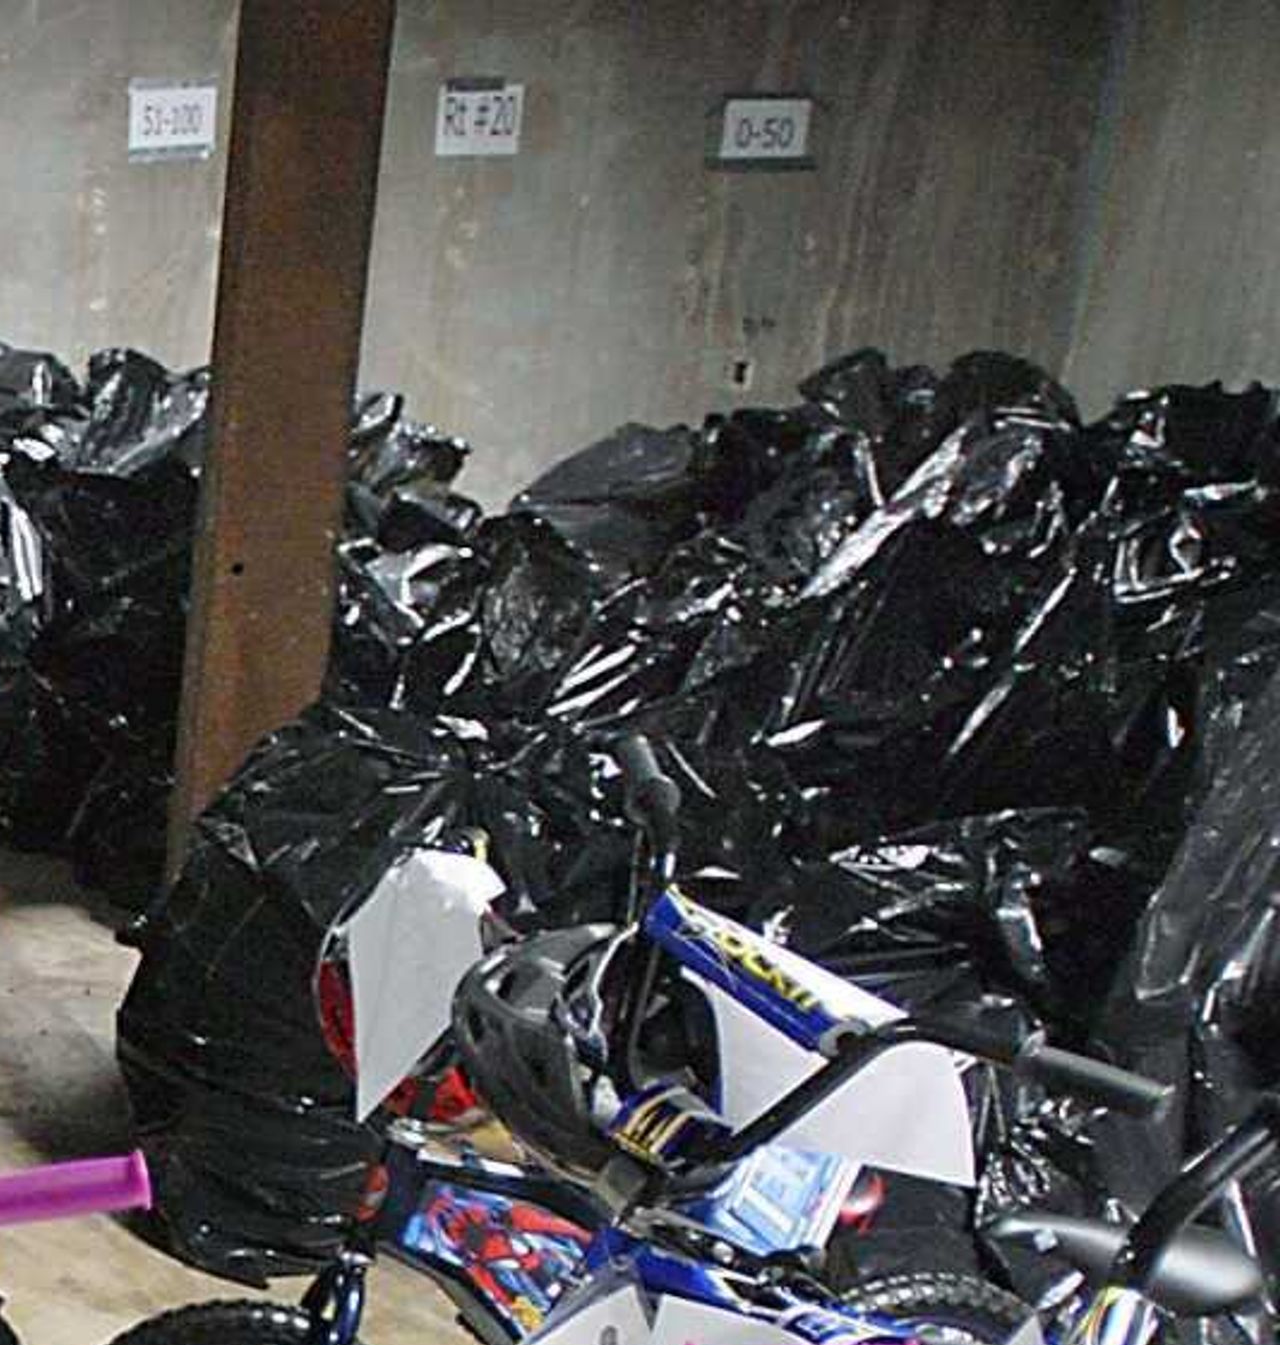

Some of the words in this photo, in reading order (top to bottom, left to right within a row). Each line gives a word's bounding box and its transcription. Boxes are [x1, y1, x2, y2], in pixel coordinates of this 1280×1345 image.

[143, 104, 204, 136] 51-100
[442, 97, 467, 136] Rt
[473, 95, 516, 136] #20
[735, 116, 795, 150] 0-50
